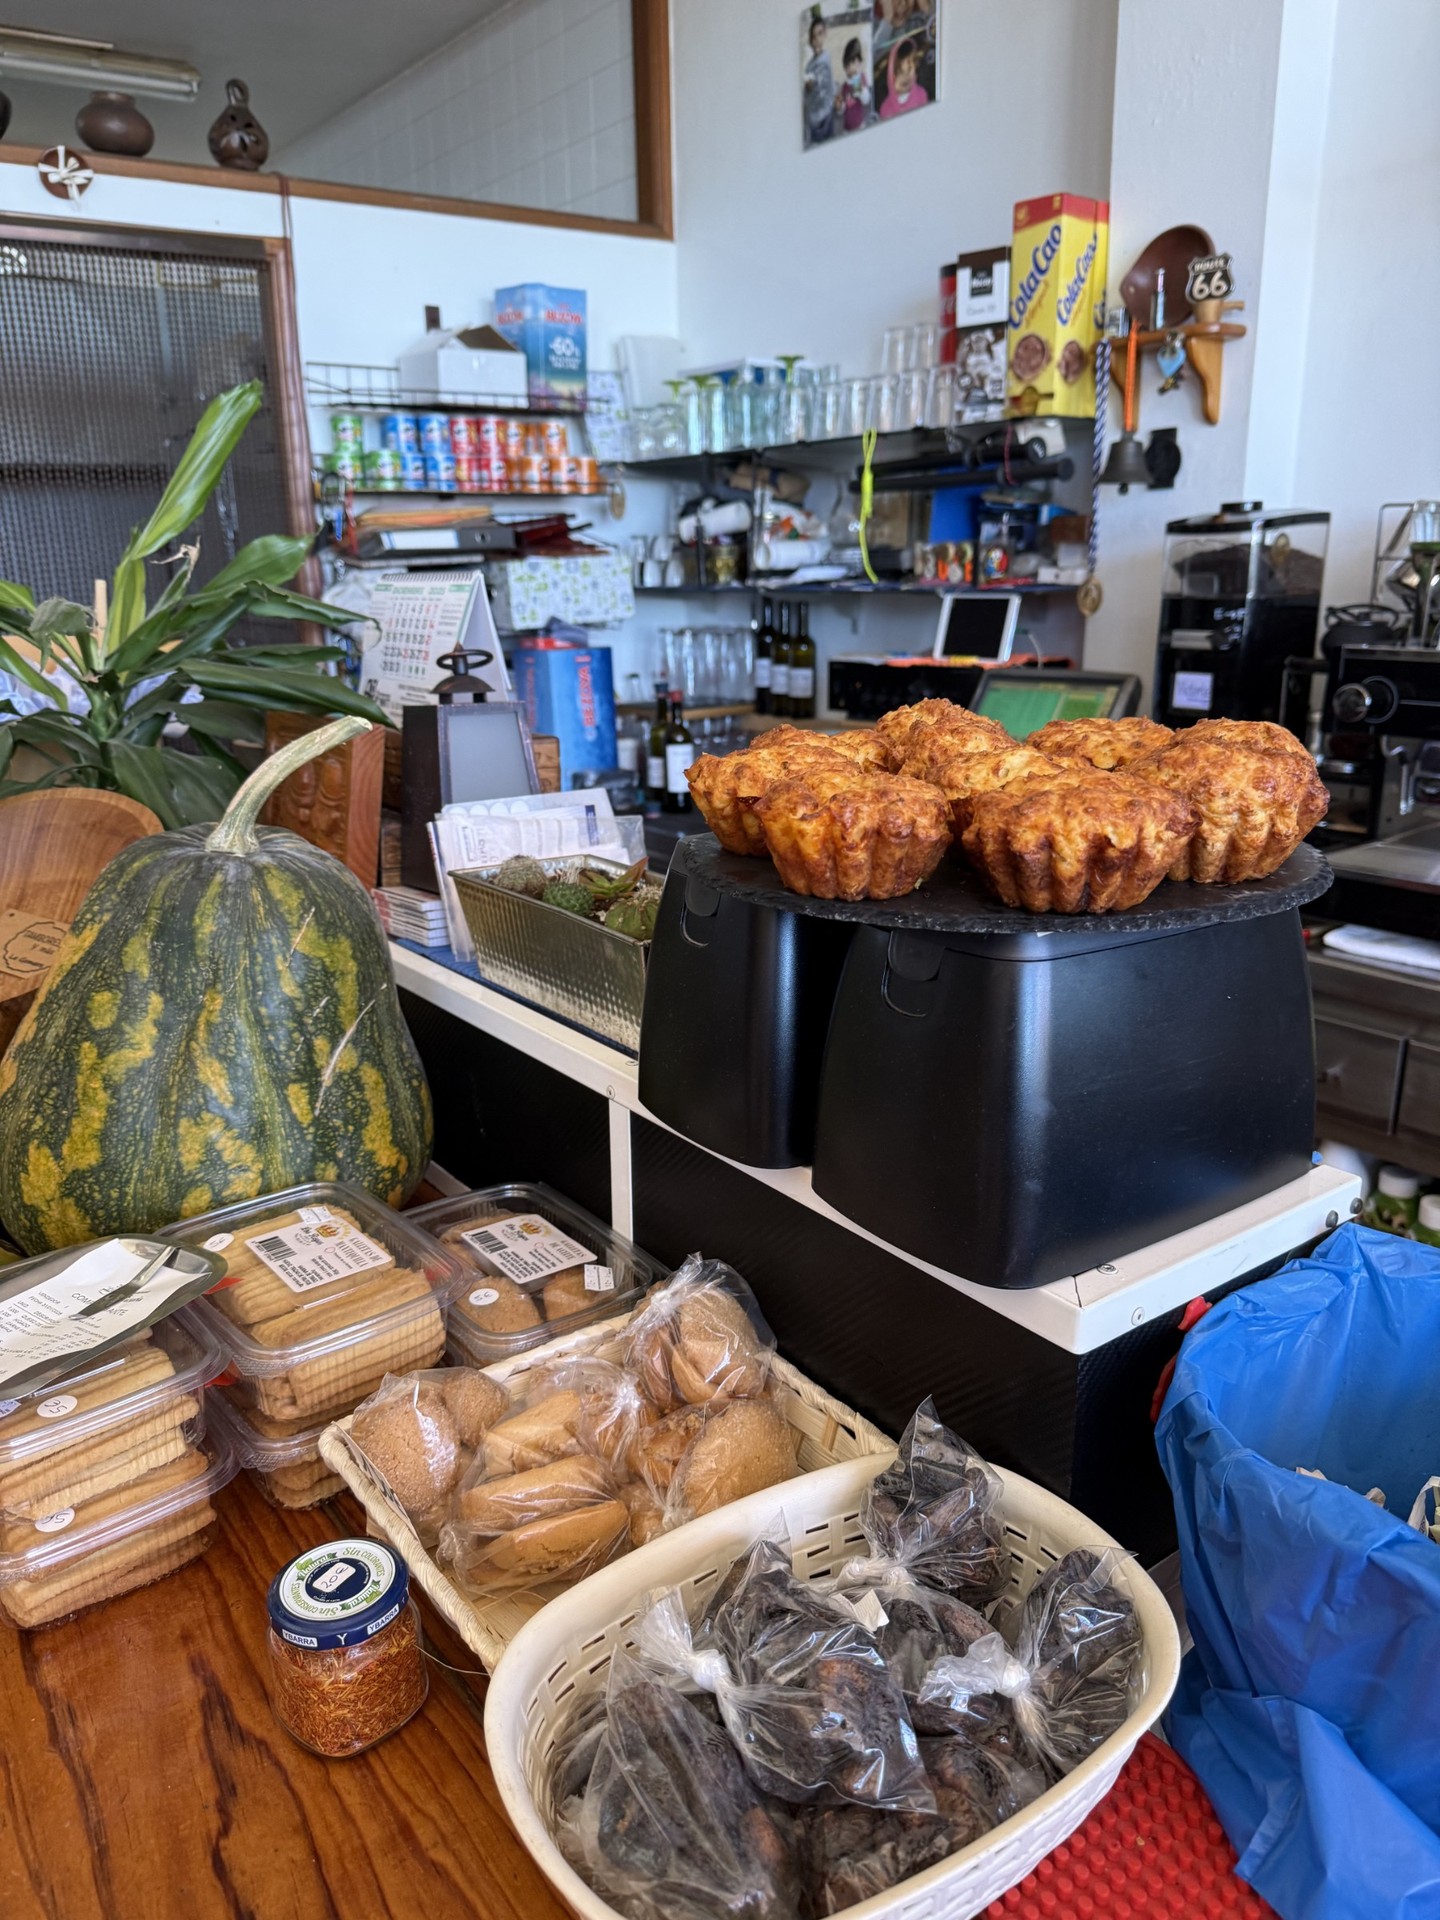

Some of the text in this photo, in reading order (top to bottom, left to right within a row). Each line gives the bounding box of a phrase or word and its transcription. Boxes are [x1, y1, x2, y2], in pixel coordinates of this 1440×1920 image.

[1009, 224, 1062, 330] ColaCao
[1192, 270, 1229, 300] 66
[301, 1553, 329, 1579] Natural
[342, 1546, 361, 1557] Sin
[360, 1551, 386, 1577] COLORANTES
[290, 1581, 339, 1617] Sin CONSERVANTES
[349, 1583, 381, 1609] Natural
[369, 1607, 399, 1632] YBARRA
[283, 1631, 316, 1647] YBARRA
[336, 1632, 348, 1646] Y
